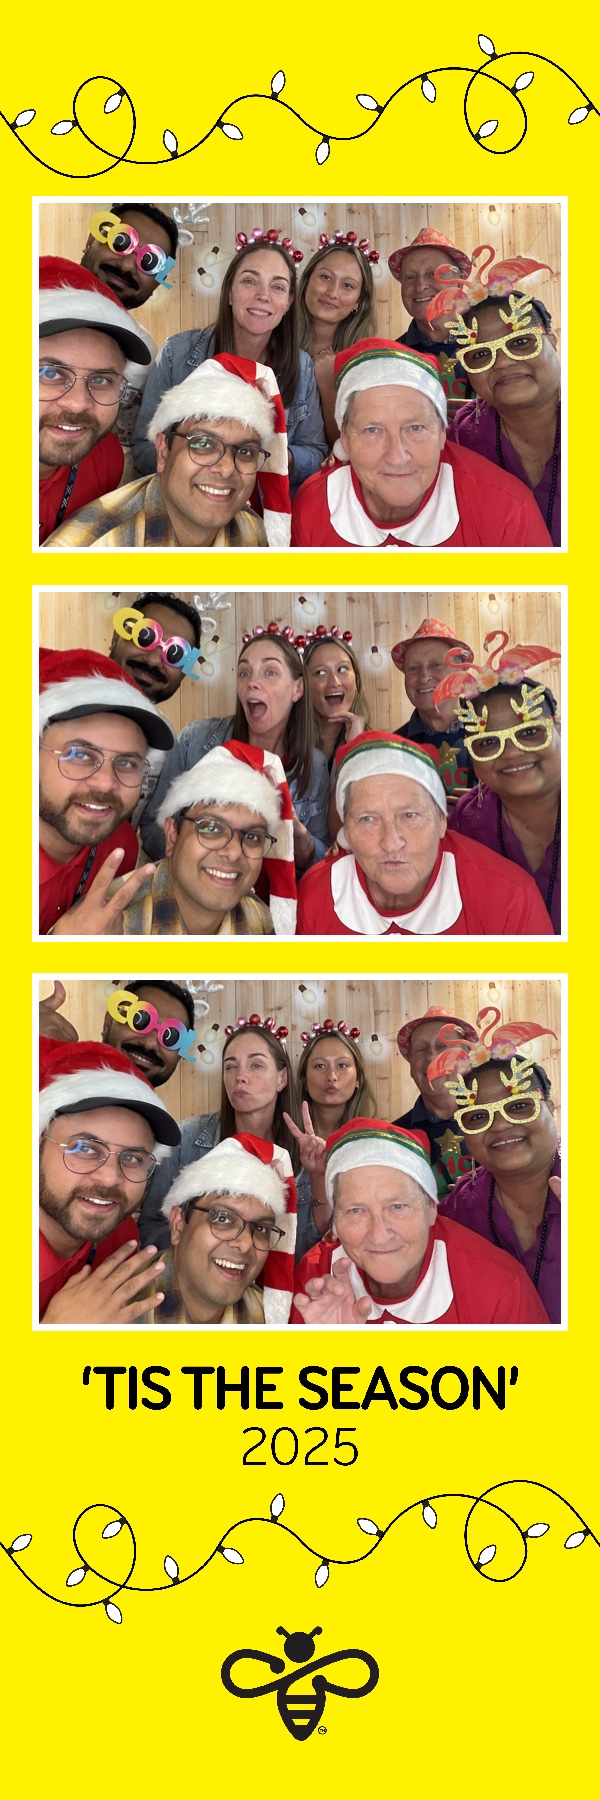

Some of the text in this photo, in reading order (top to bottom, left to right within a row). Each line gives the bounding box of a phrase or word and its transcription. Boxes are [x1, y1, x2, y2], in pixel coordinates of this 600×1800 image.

[88, 211, 176, 290] COOL
[113, 607, 202, 681] COOL
[107, 990, 198, 1064] COOL
